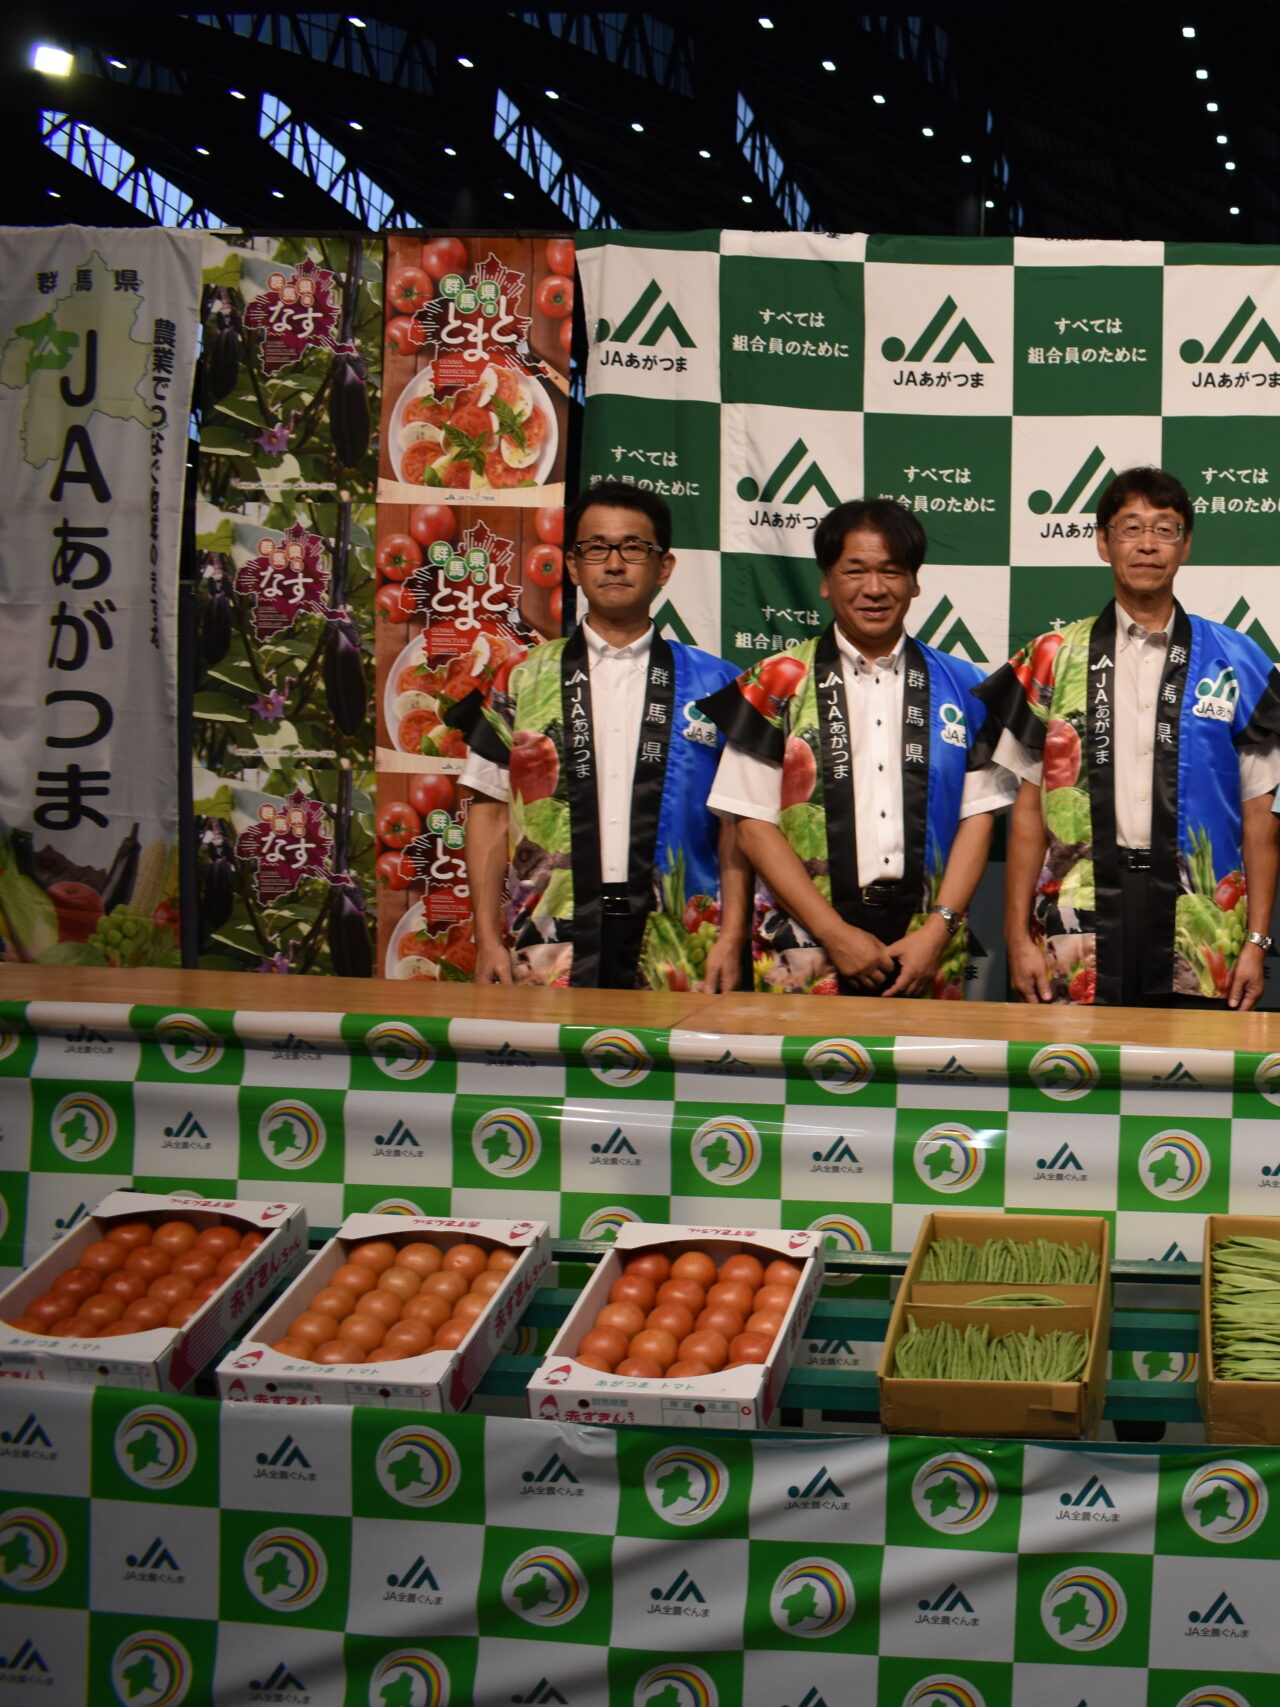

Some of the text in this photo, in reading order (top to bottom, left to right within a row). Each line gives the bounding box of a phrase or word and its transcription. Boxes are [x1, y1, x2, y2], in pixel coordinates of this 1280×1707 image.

[37, 269, 140, 294] 群馬県
[269, 301, 323, 338] なす
[440, 295, 519, 361] とまと
[759, 308, 826, 329] すべては
[1054, 317, 1123, 335] すべては
[732, 333, 849, 358] 組合員のために
[1027, 346, 1147, 365] 組合員のために
[600, 349, 688, 373] JAあがつま
[893, 370, 985, 388] JAあがつま
[610, 445, 678, 467] すべては
[903, 465, 972, 484] すべては
[1201, 467, 1269, 484] すべては
[748, 510, 822, 529] JAあがつ
[33, 329, 117, 831] JAあがつま
[260, 566, 313, 603] なす
[431, 563, 509, 630] とまと
[761, 604, 821, 626] すべては
[904, 669, 925, 764] 群馬県
[1094, 672, 1110, 765] JAあがつま
[570, 686, 591, 779] JAあがつま
[827, 690, 849, 780] JAあがつま
[262, 832, 316, 868] なす
[595, 1379, 695, 1391] あがつま トマト
[1055, 1510, 1121, 1523] JA全農ぐんま
[1184, 1626, 1250, 1639] JA全農ぐんま
